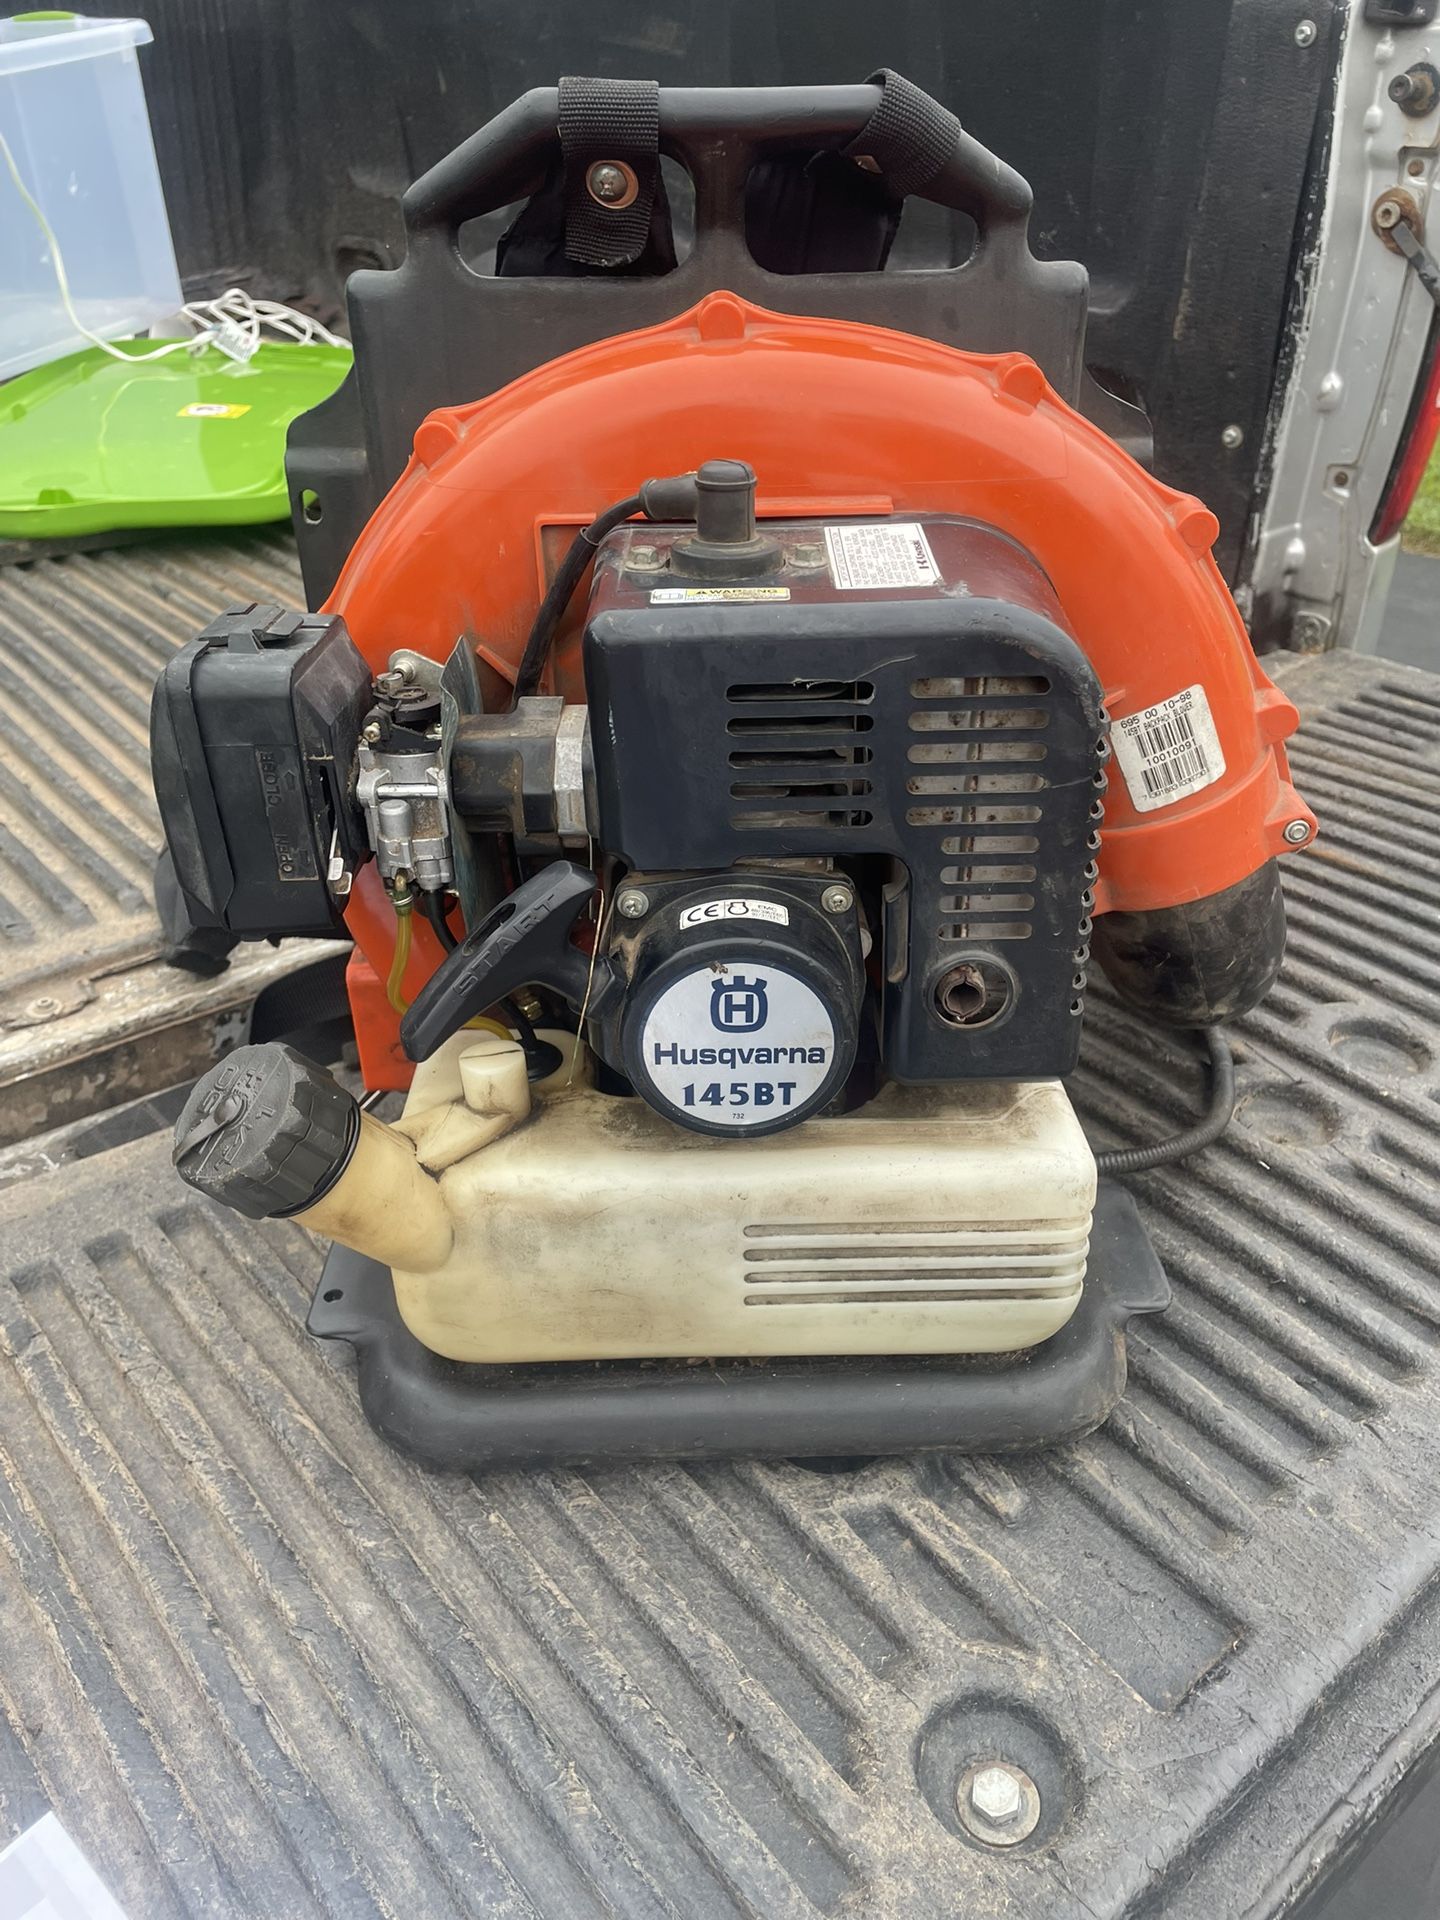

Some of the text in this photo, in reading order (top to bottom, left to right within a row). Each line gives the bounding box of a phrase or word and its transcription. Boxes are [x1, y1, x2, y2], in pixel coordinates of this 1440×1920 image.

[1120, 690, 1192, 729] 695 00 10-98
[1146, 738, 1197, 766] 10010091
[274, 833, 294, 874] OPEN
[453, 893, 555, 997] START
[654, 1042, 826, 1069] Husqvarna
[682, 1082, 797, 1107] 145BT
[732, 1112, 745, 1120] 732
